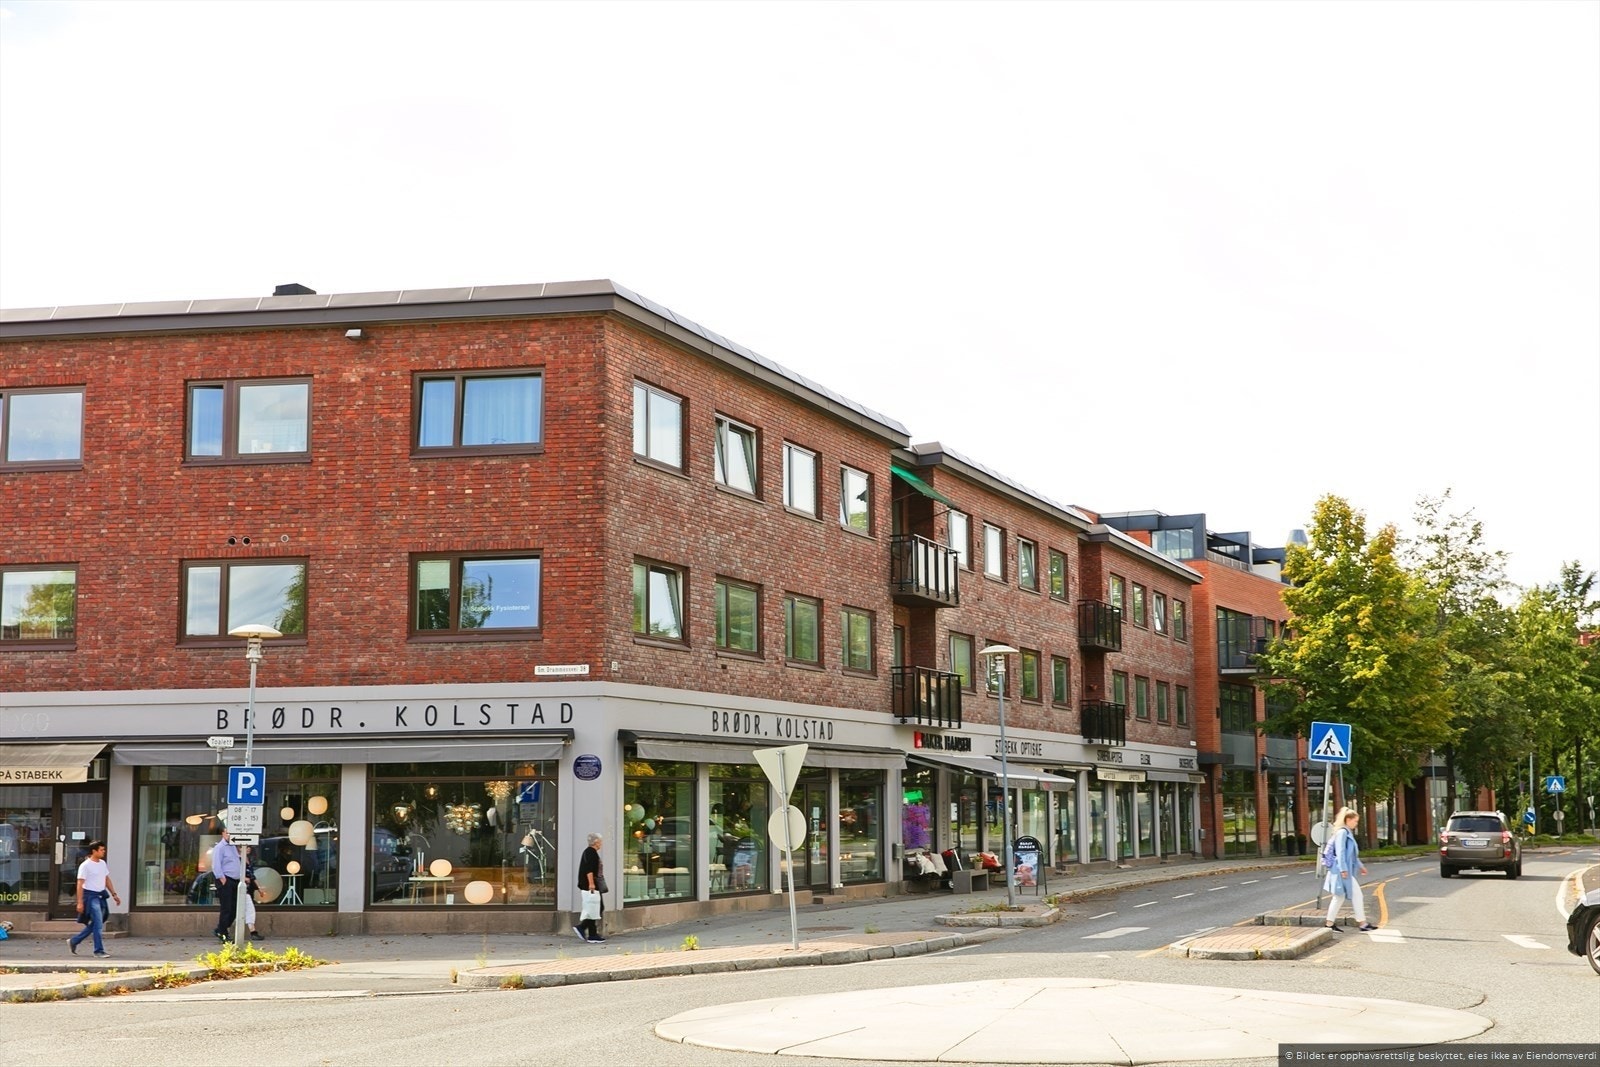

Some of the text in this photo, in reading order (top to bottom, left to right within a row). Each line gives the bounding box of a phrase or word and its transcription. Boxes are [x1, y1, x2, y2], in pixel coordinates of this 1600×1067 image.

[217, 702, 574, 730] BRØDR. KOLSTAD
[712, 710, 834, 741] BRØDR. KOLSTAD
[995, 739, 1018, 755] STBEKK
[15, 770, 62, 779] STABEKK
[237, 772, 256, 799] P
